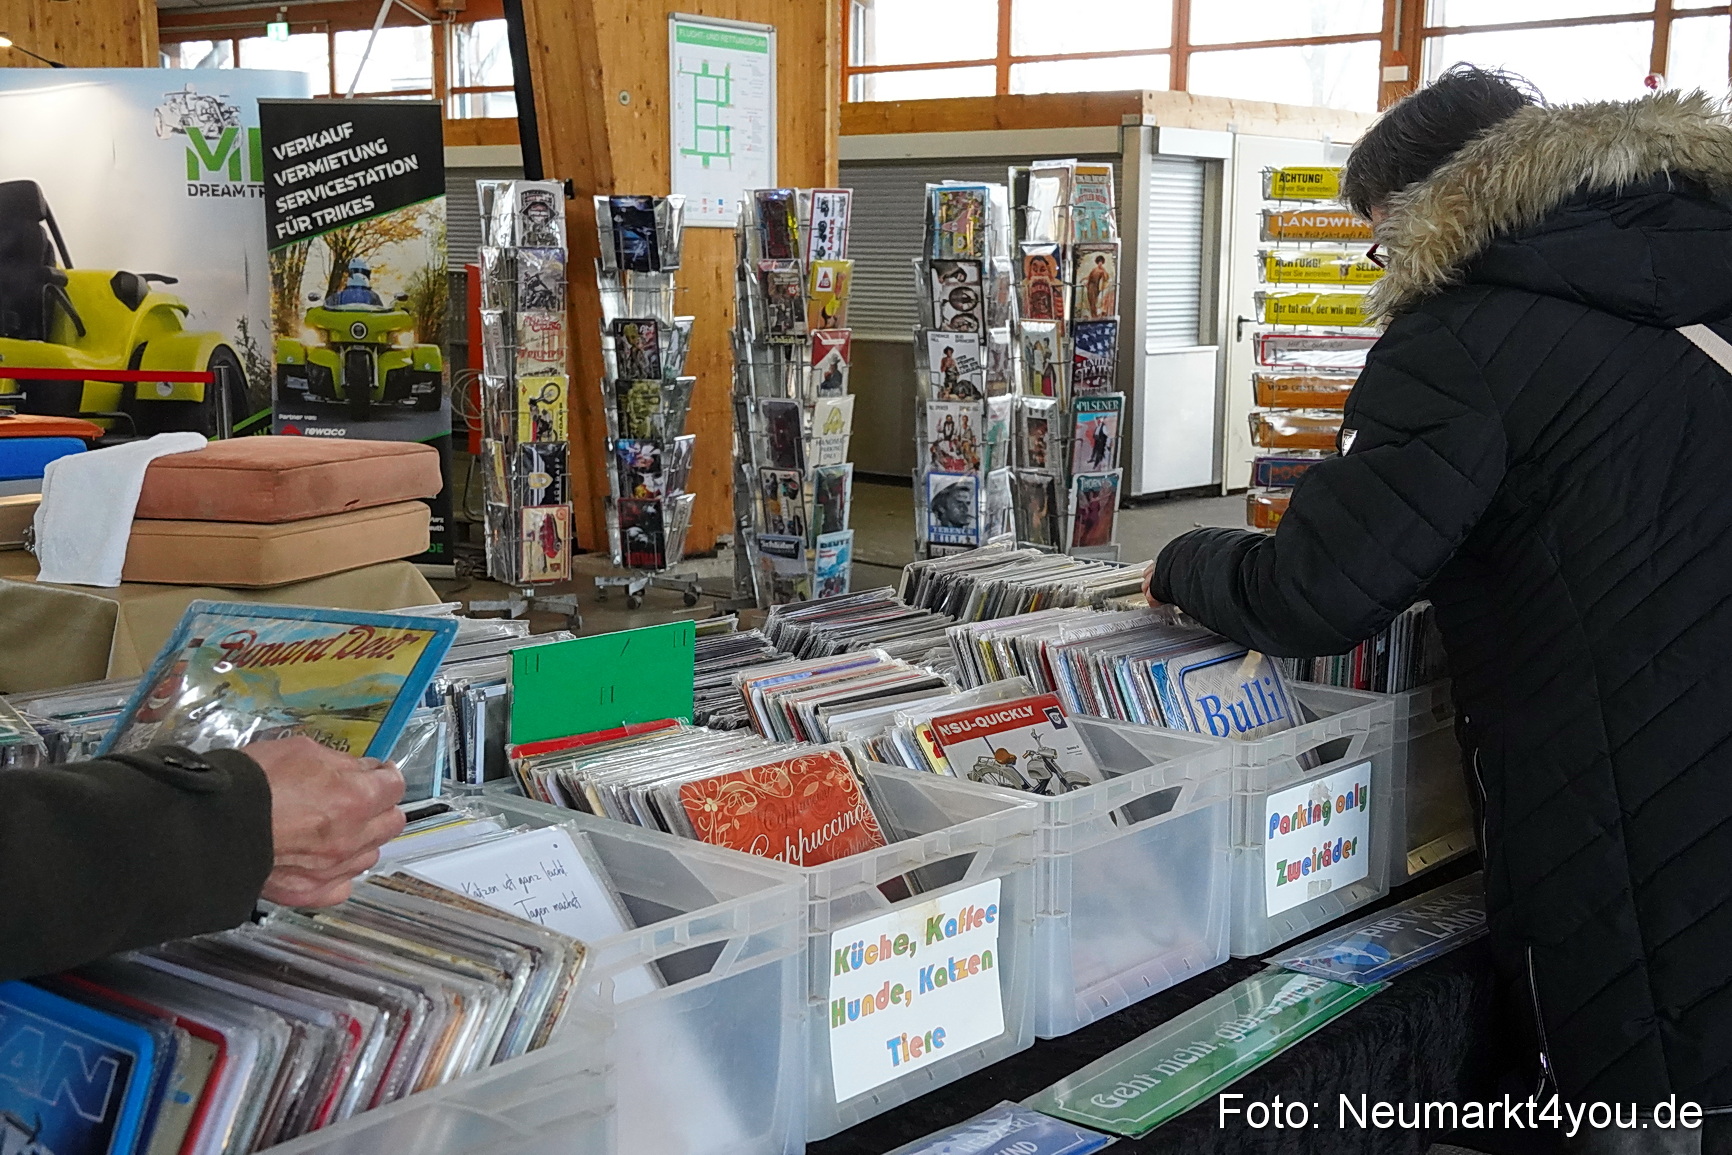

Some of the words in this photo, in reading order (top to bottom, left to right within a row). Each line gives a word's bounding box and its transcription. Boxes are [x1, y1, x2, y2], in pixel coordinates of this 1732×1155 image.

[272, 122, 354, 161] VERKAUF
[273, 138, 389, 187] VERMIETUNG
[275, 154, 419, 214] SERVICESTATION
[1278, 172, 1324, 184] ACHTUNG!
[275, 213, 314, 240] FÜR
[311, 195, 375, 232] TRIKES
[1273, 303, 1285, 313] Der
[1288, 304, 1299, 313] tut
[1316, 304, 1328, 314] der
[1078, 400, 1120, 413] PILSENER
[305, 427, 346, 437] rewaco
[937, 705, 1035, 738] NSU-QUICKLY
[1197, 677, 1285, 738] Bulli
[1268, 799, 1332, 840] Parking
[1335, 782, 1368, 813] only
[1276, 836, 1358, 887] Zweiräder
[833, 934, 917, 977] Küche,
[925, 903, 998, 946] Kaffee
[1414, 908, 1487, 939] LAND
[831, 980, 913, 1029] Hunde,
[919, 950, 994, 995] Katzen
[886, 1026, 947, 1067] Tiere
[1090, 1062, 1163, 1110] Geht
